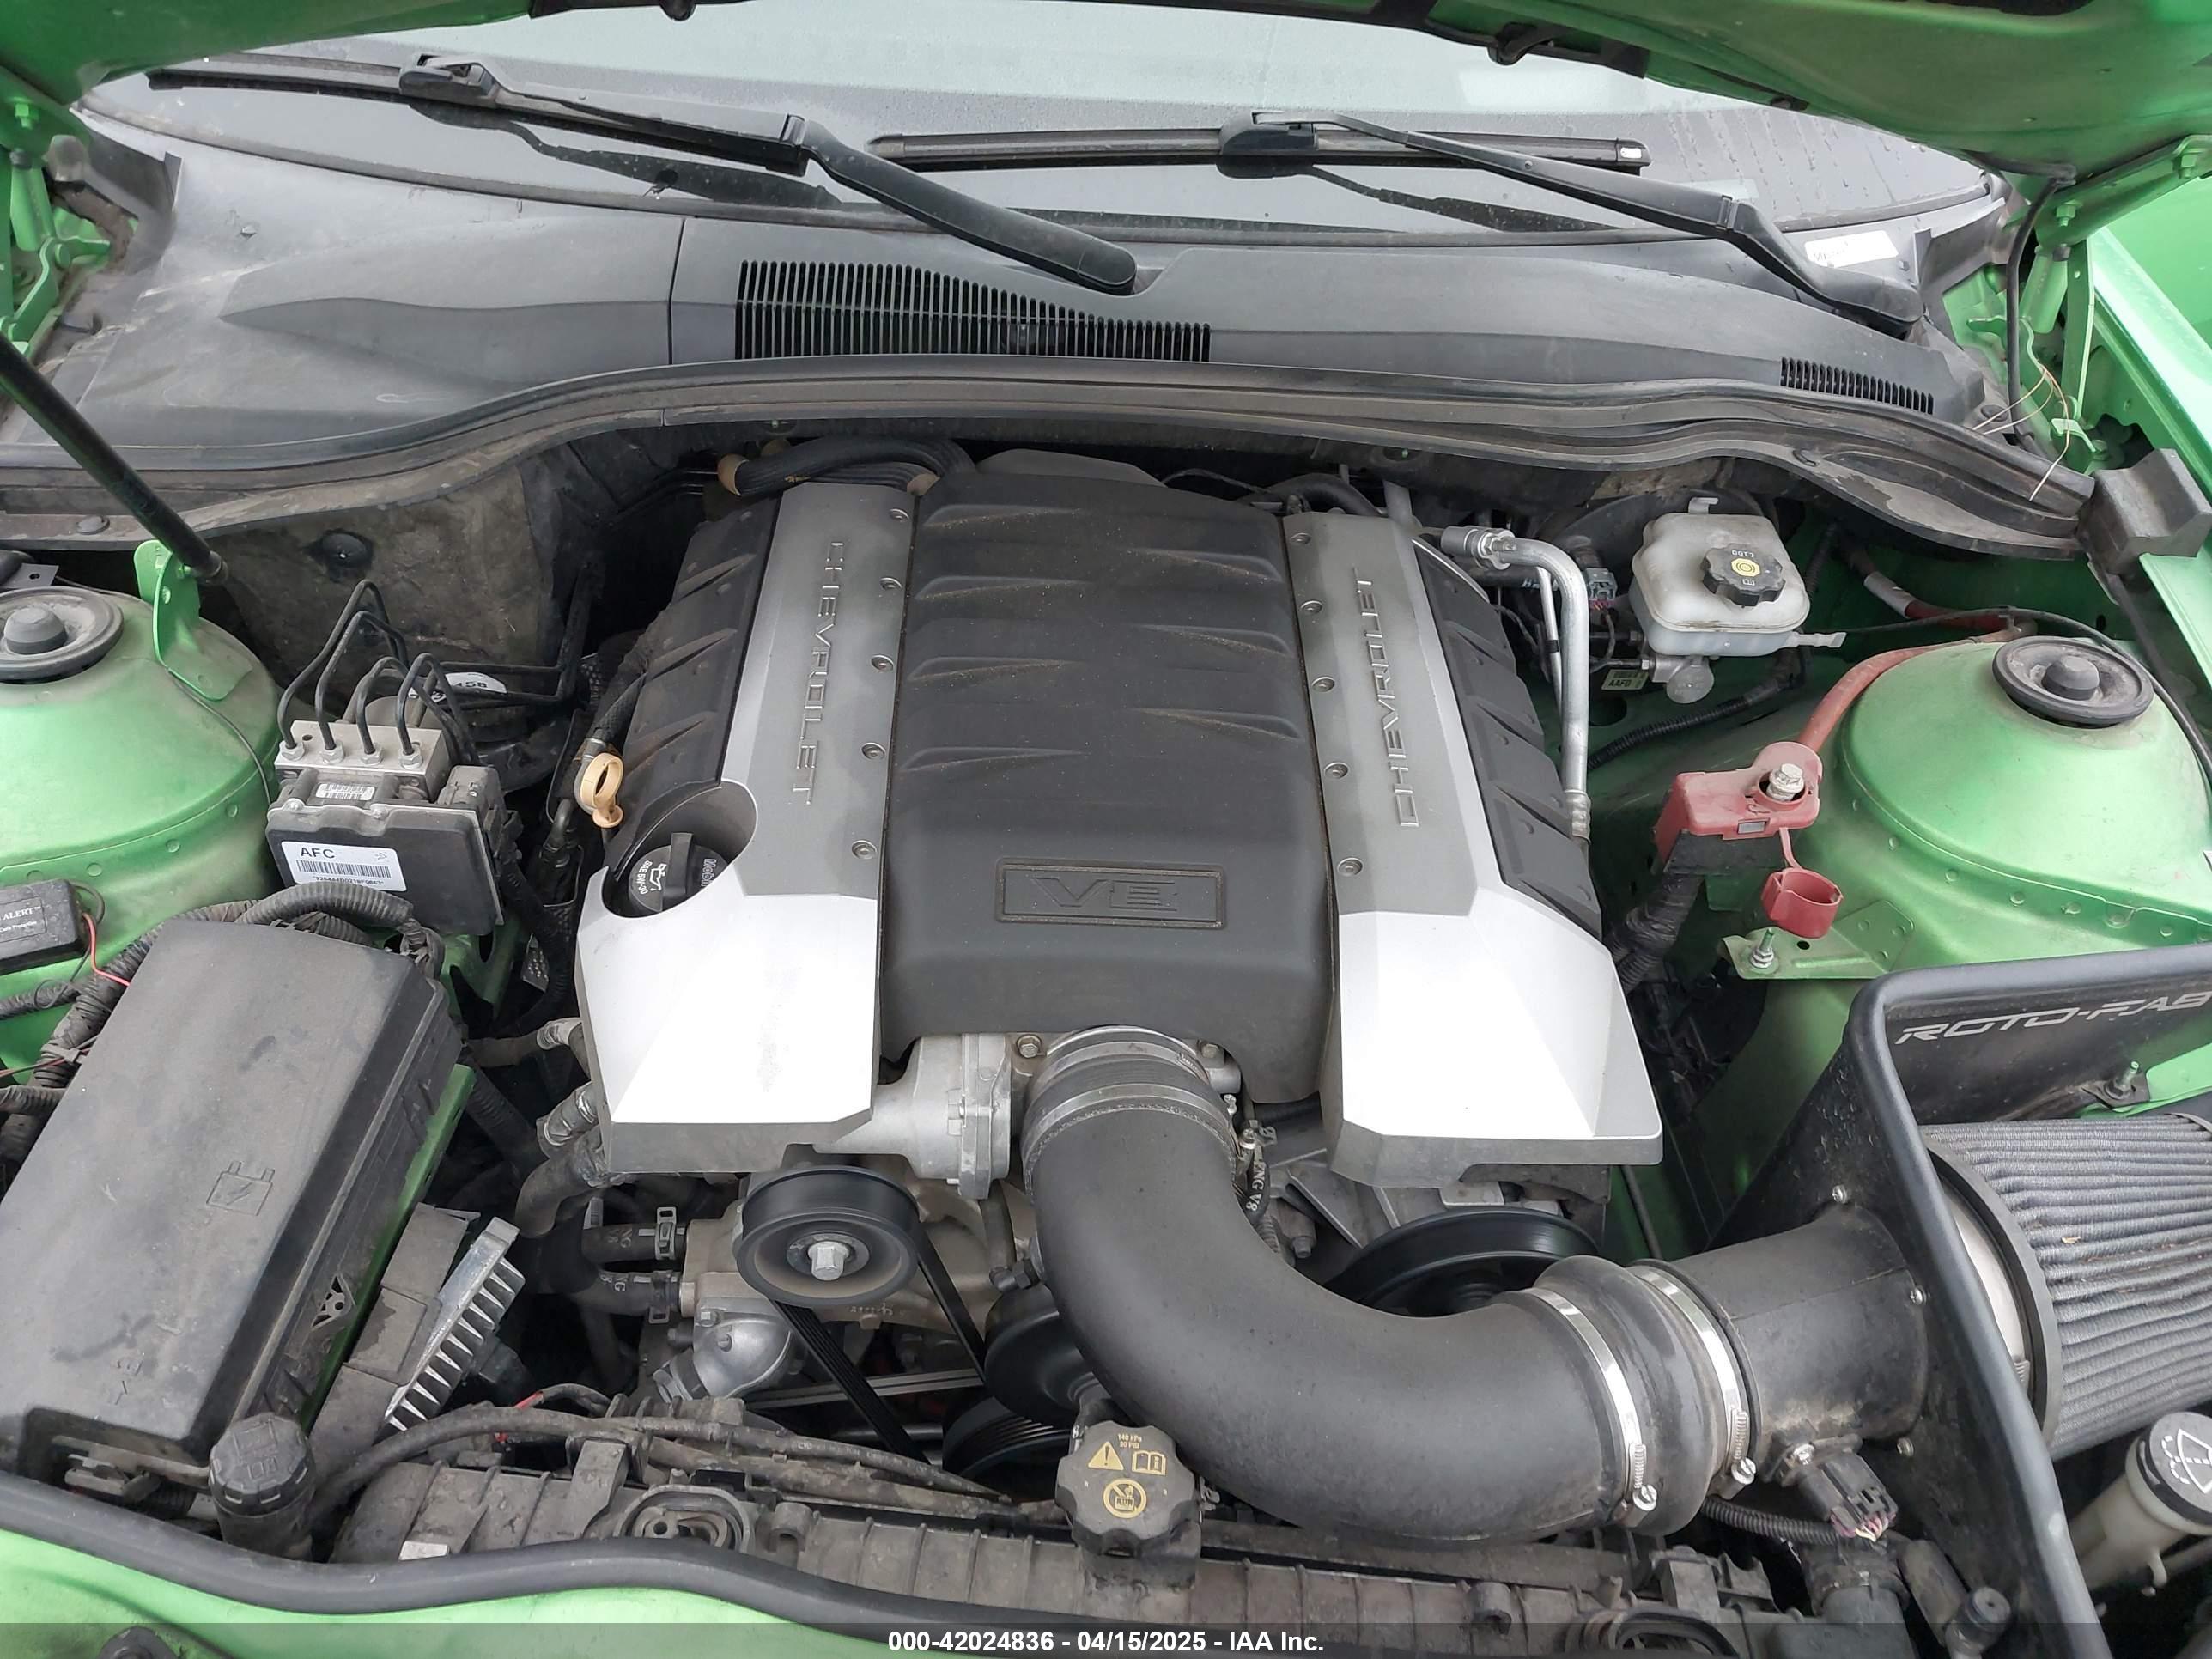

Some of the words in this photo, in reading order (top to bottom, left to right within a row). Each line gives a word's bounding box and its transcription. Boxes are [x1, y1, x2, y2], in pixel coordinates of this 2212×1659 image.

[792, 542, 844, 805] CHEVROLET
[1353, 567, 1419, 828] CHEVROLET
[301, 847, 336, 859] AFC
[638, 860, 653, 874] SAE
[1245, 1194, 1262, 1212] V8
